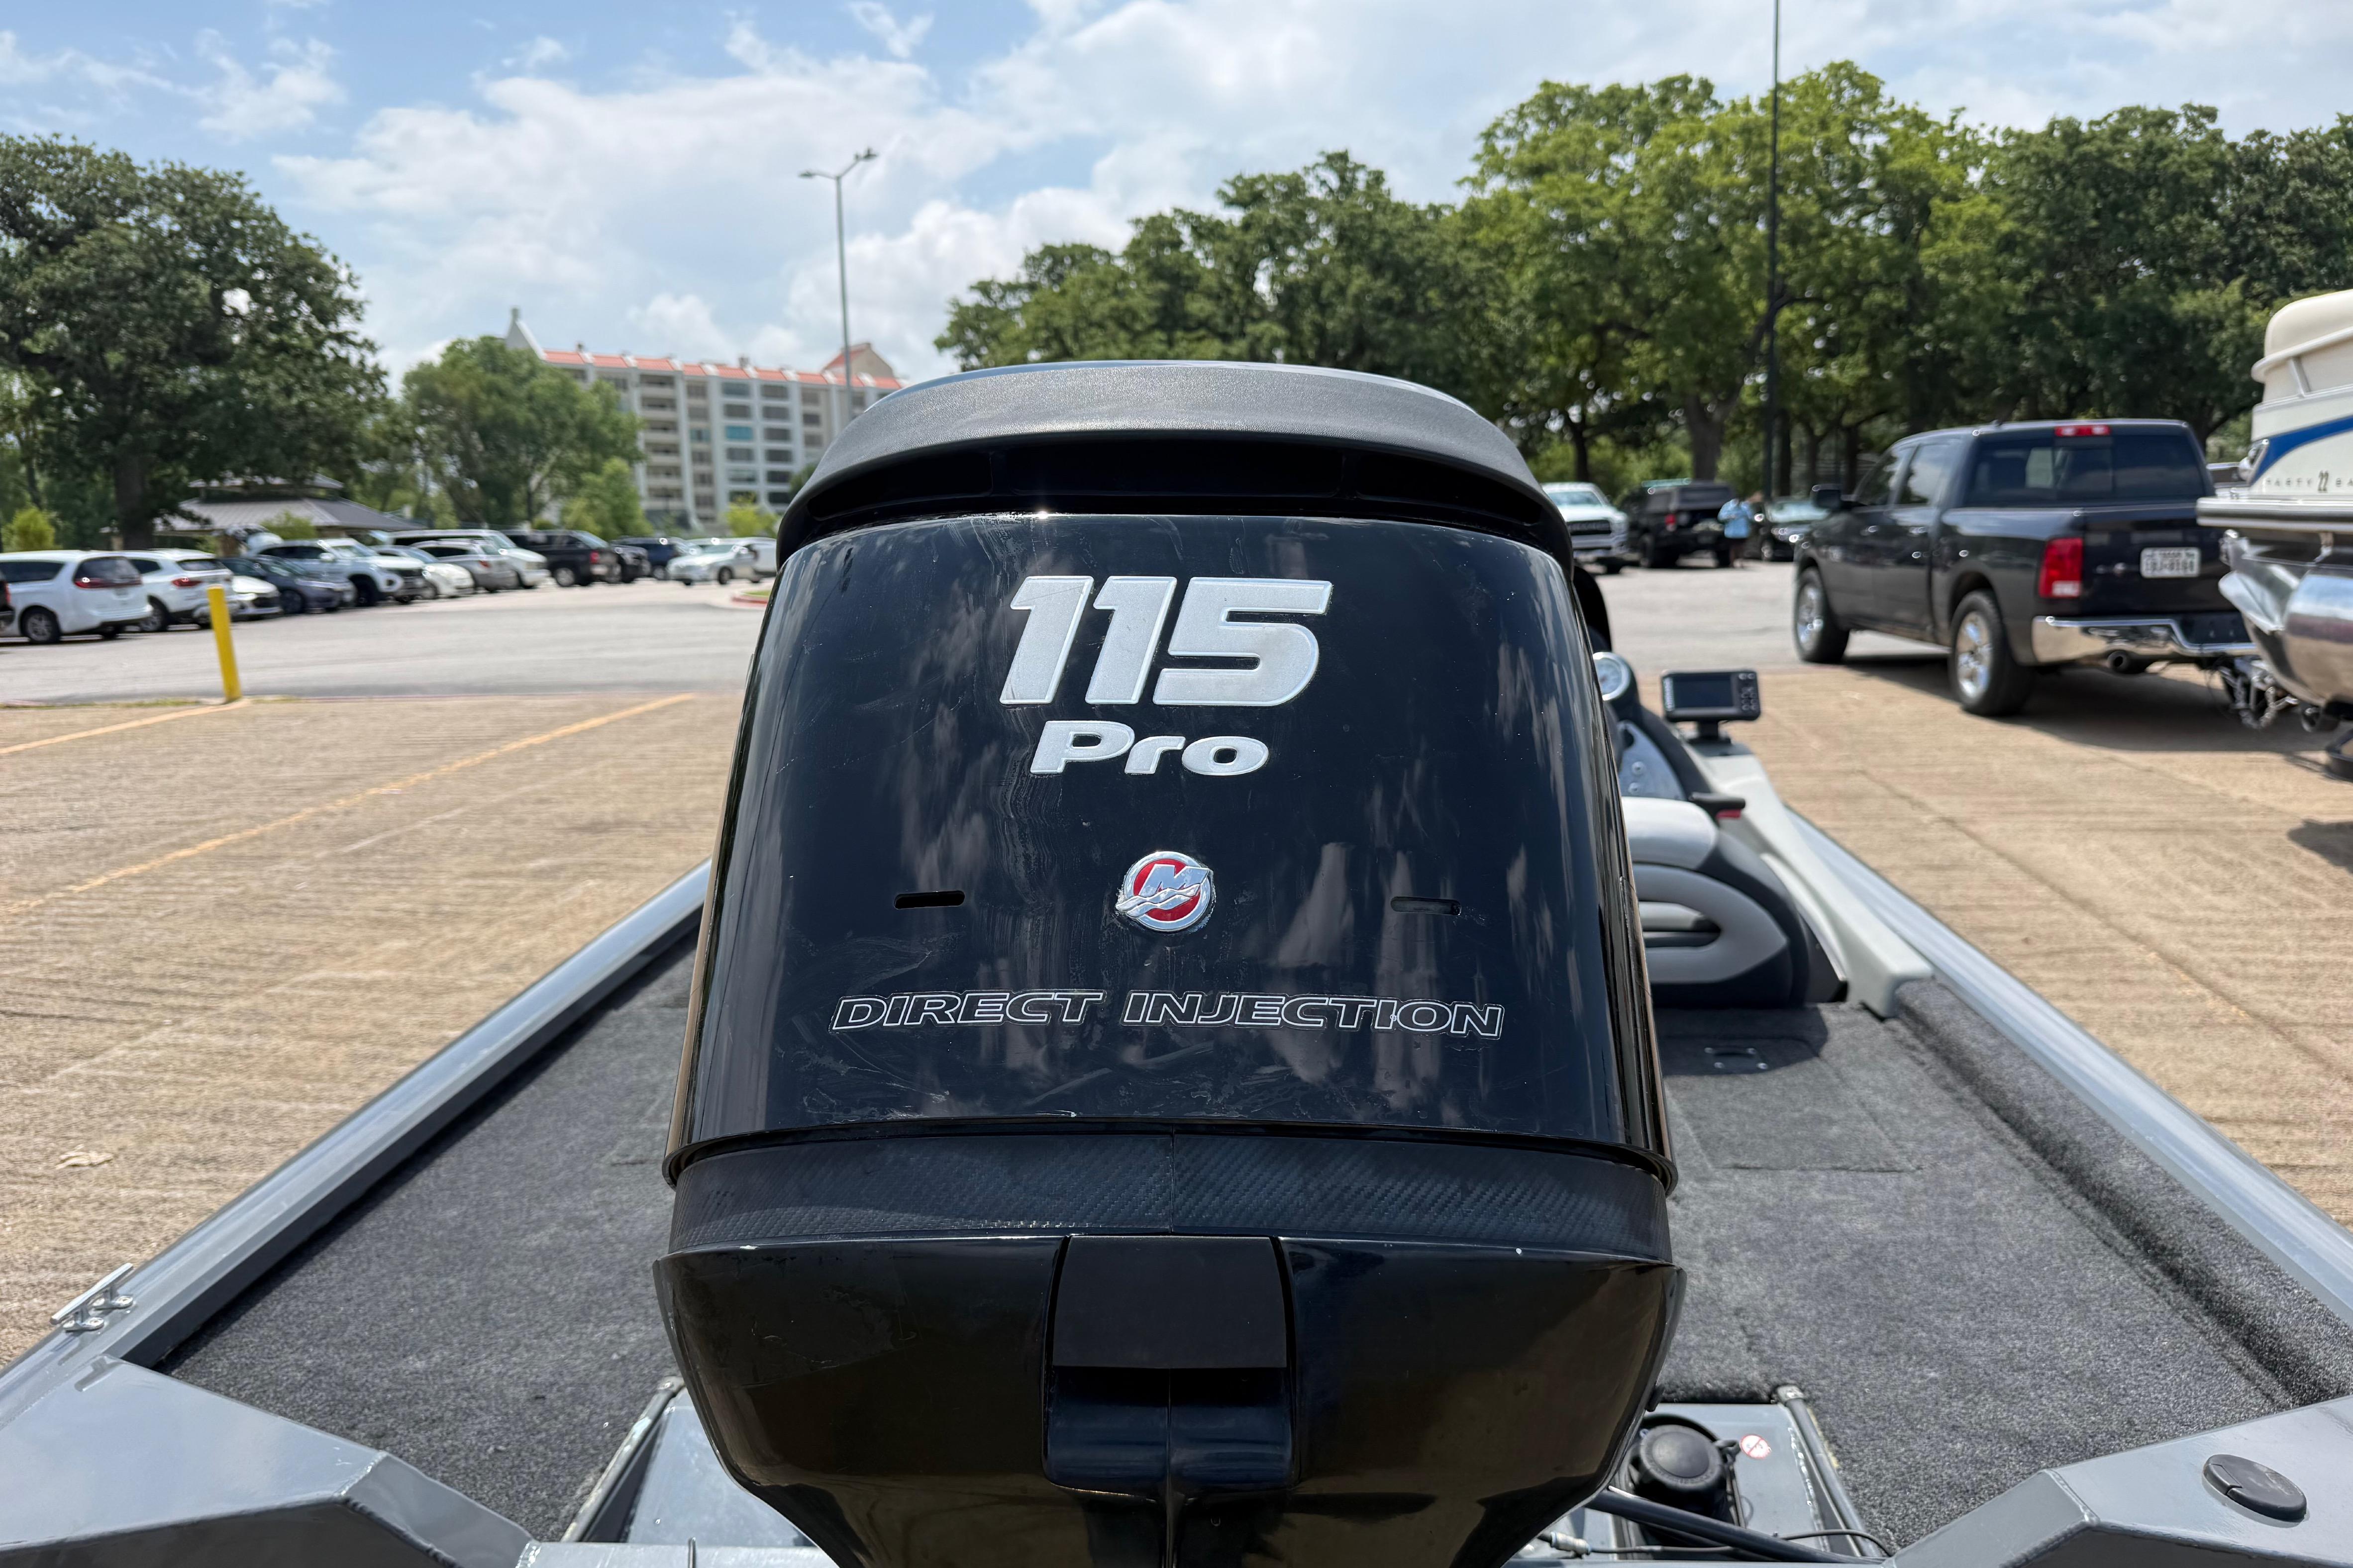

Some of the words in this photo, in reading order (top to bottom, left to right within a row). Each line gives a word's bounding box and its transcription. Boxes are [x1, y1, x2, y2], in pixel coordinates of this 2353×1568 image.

[999, 576, 1332, 706] 115
[1030, 721, 1269, 776] Pro
[832, 992, 1103, 1030] DIRECT
[1123, 993, 1503, 1037] INJECTION
